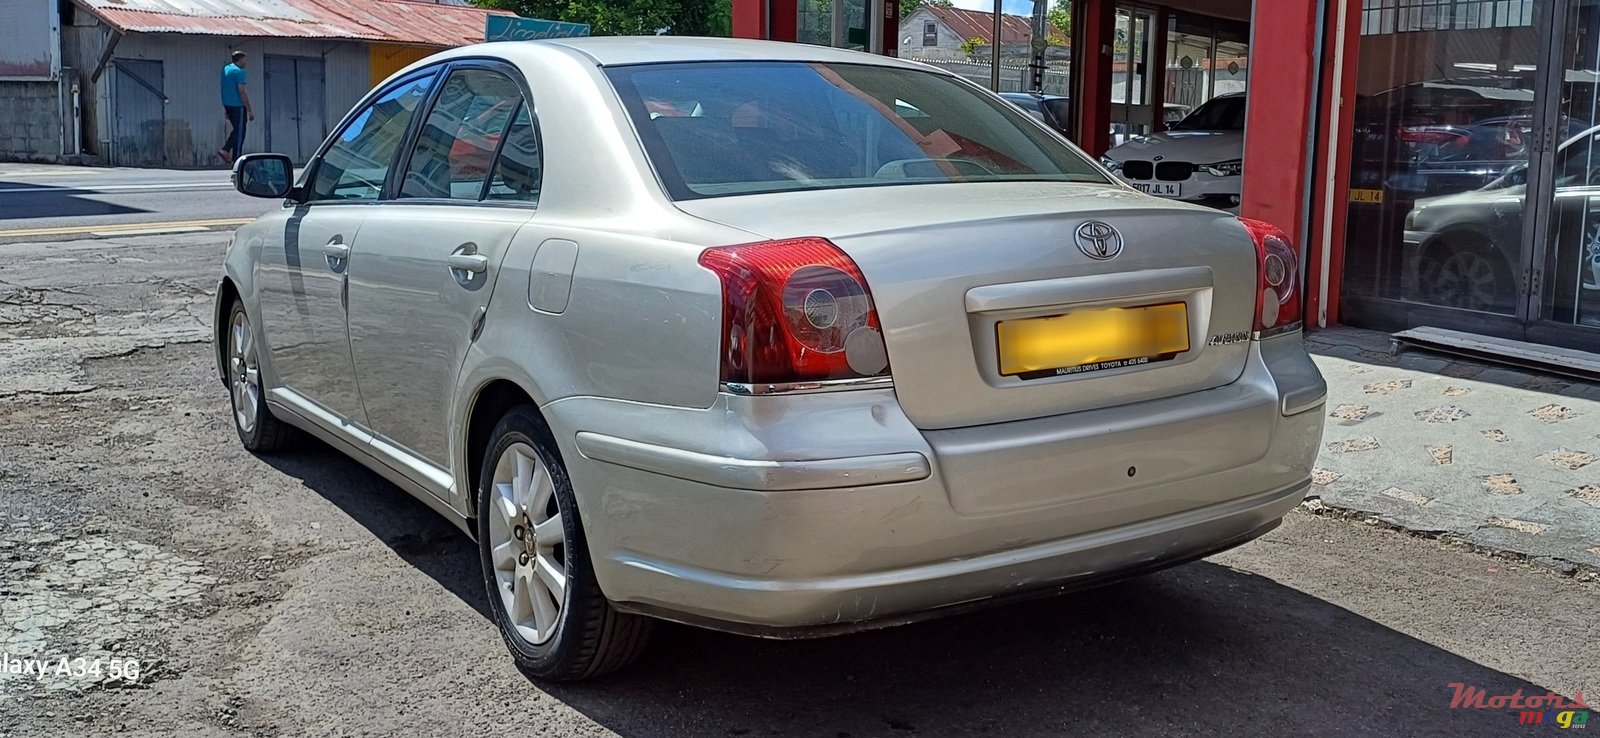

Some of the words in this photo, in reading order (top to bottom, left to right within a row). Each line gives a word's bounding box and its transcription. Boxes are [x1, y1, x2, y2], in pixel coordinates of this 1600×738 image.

[1152, 184, 1163, 194] JL
[1165, 185, 1174, 194] 14
[1354, 191, 1366, 201] JL
[1370, 191, 1380, 202] 14
[1100, 361, 1121, 369] TOYOTA
